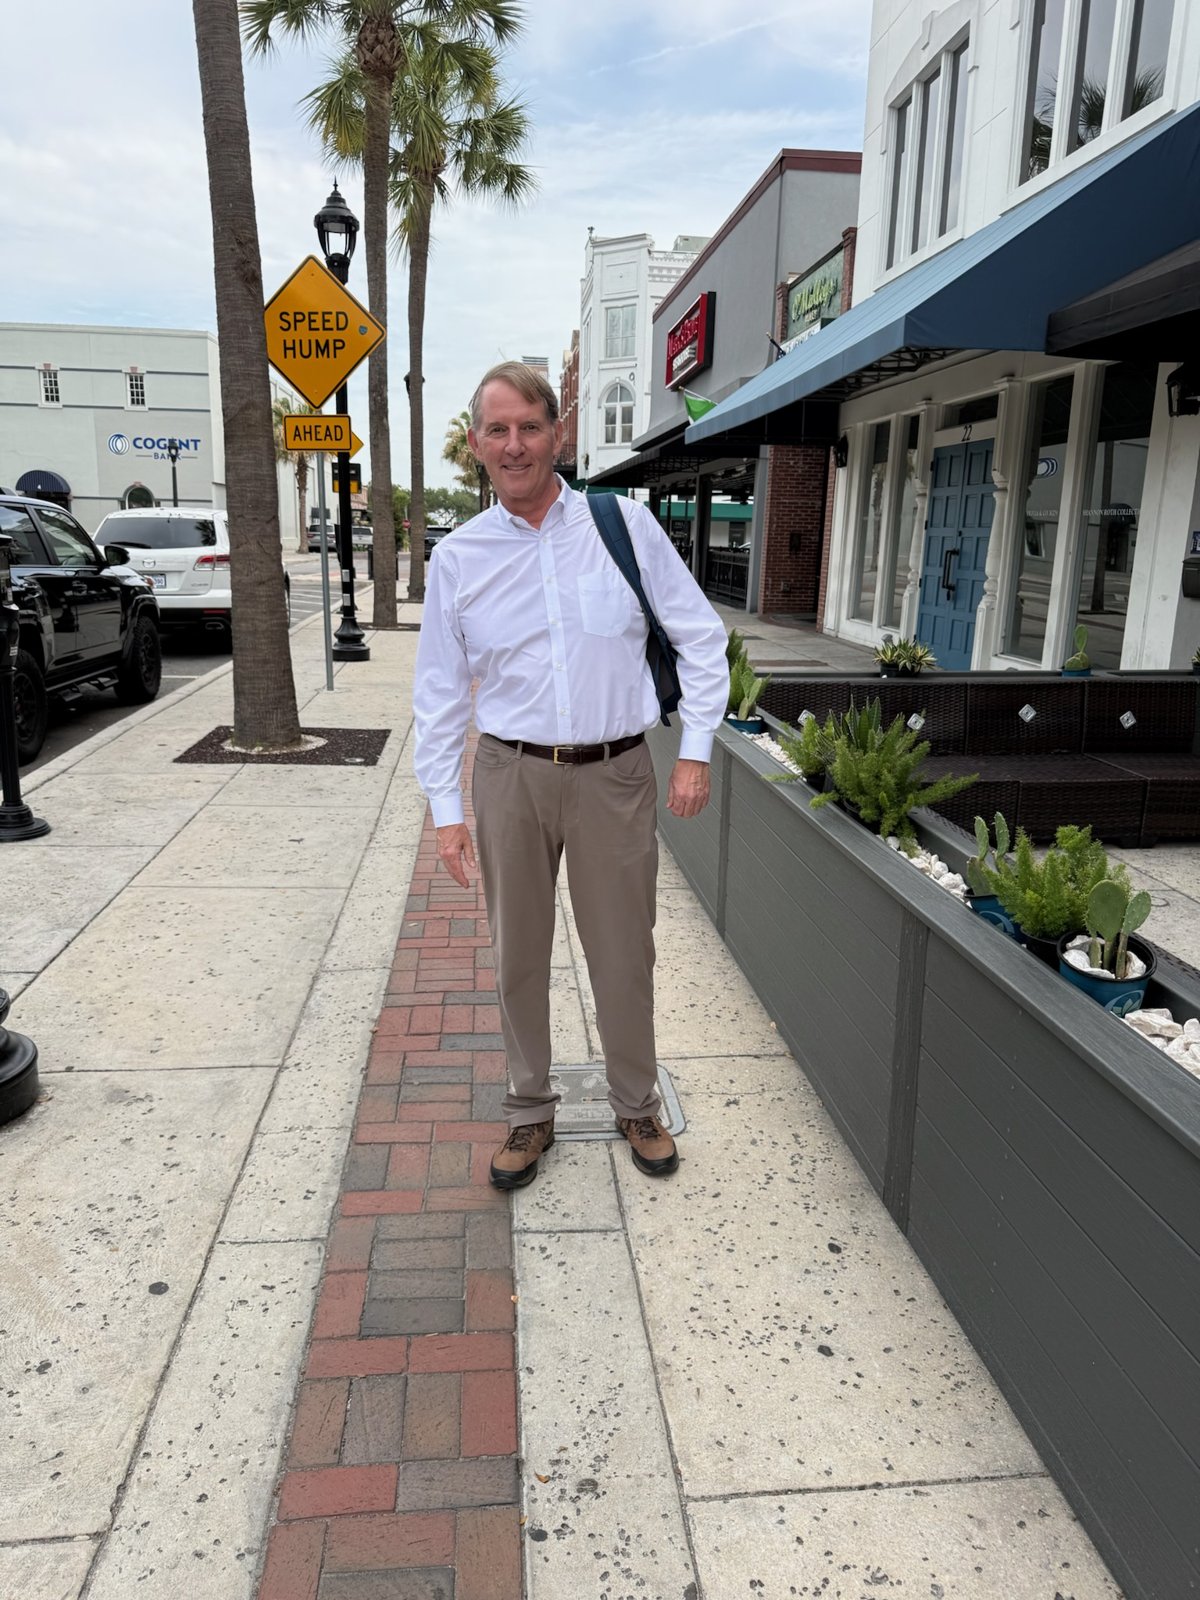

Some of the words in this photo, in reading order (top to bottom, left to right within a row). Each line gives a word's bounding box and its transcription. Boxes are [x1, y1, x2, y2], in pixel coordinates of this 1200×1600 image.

[279, 311, 349, 332] SPEED
[283, 339, 346, 359] HUMP
[293, 425, 344, 442] AHEAD
[961, 424, 973, 442] 22
